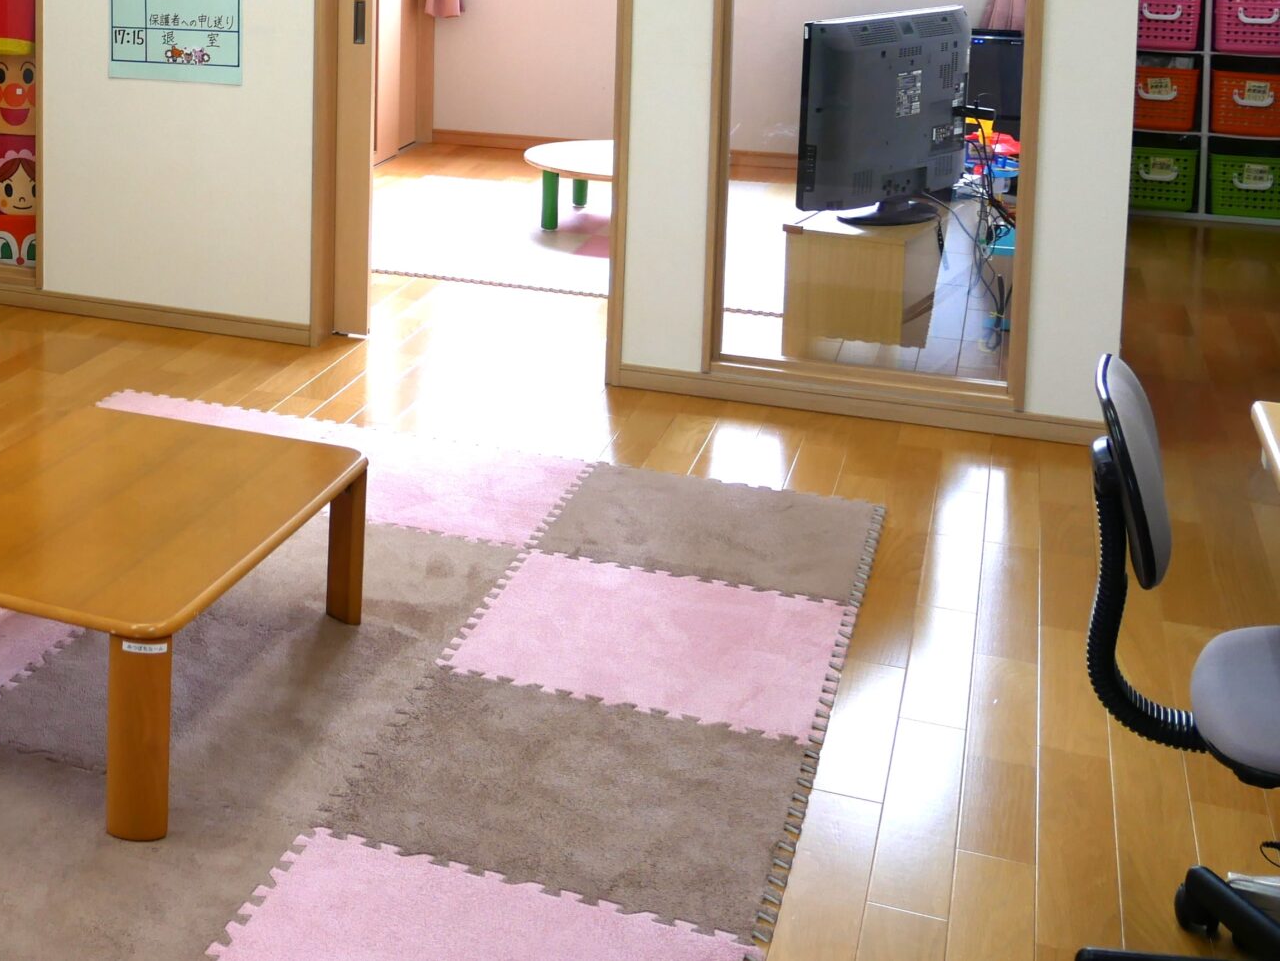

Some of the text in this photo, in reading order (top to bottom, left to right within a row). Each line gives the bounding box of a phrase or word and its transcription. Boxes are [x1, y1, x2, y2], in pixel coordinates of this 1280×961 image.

[149, 14, 234, 30] 保護者への申し送り
[114, 29, 144, 45] 17:15
